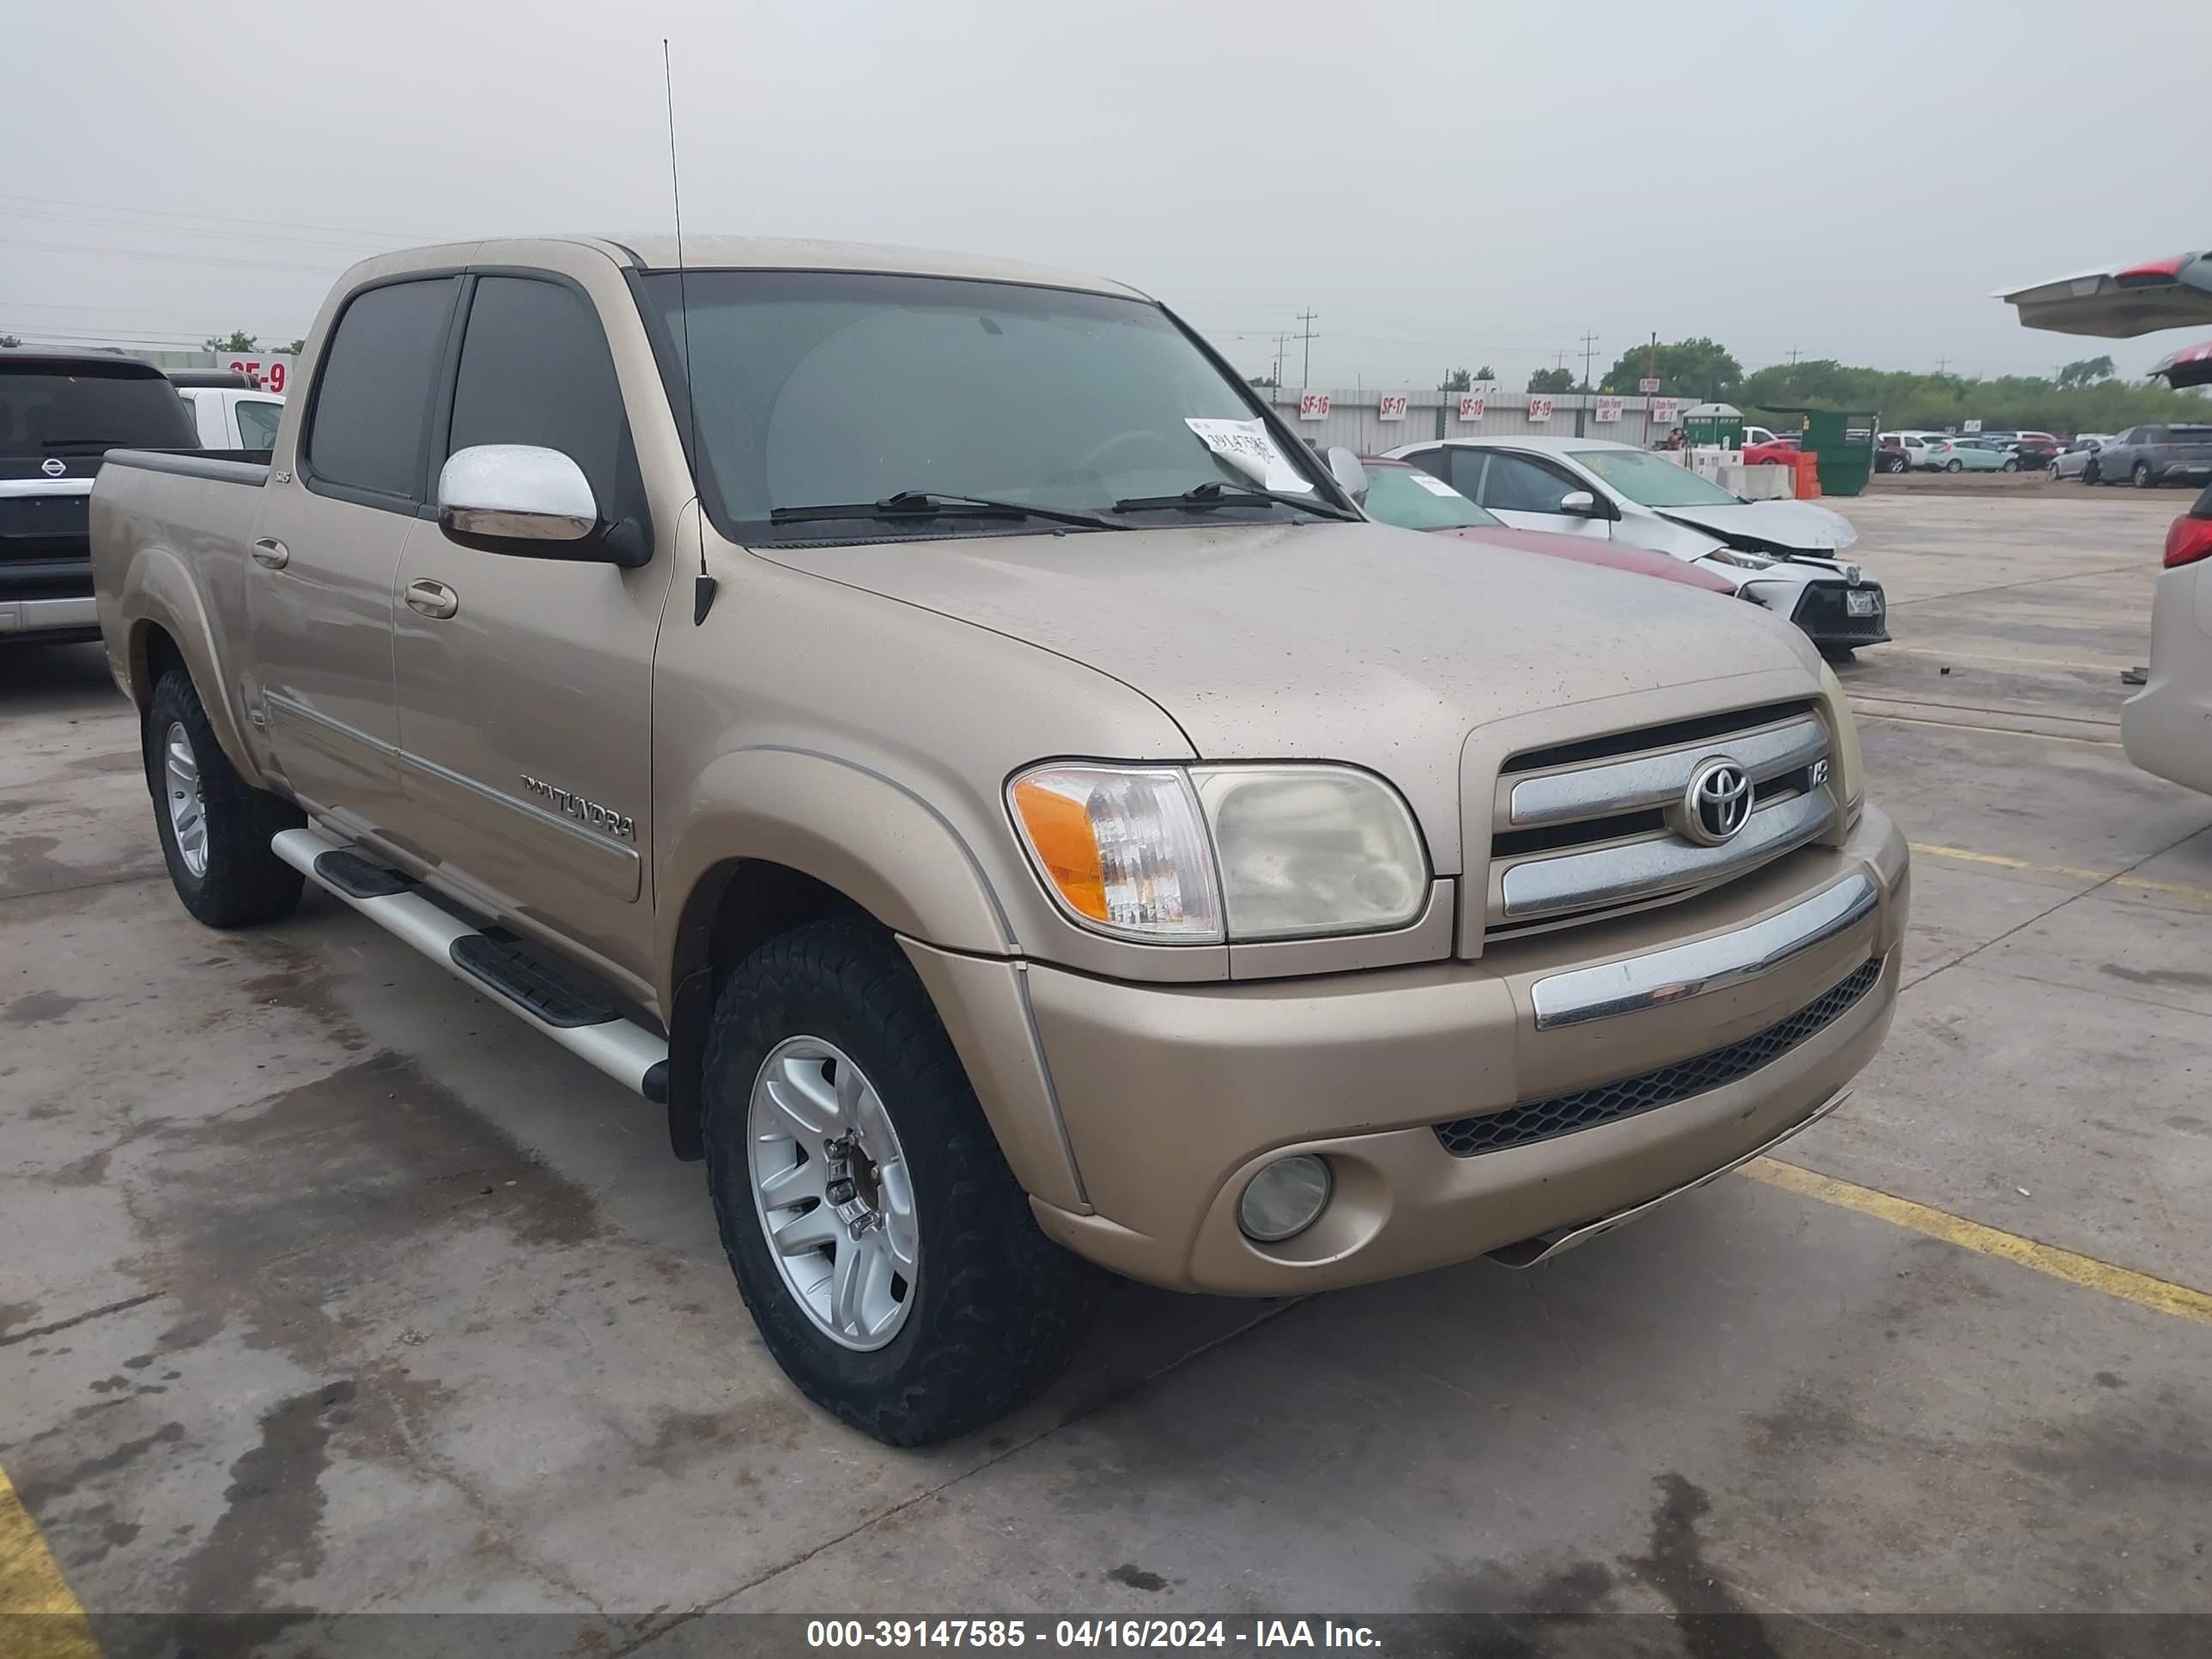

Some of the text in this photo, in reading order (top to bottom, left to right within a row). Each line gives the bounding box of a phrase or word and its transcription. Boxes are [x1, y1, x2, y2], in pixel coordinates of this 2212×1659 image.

[1302, 396, 1330, 414] SF-16
[1382, 398, 1407, 415] SF-17
[1462, 398, 1484, 416] SF-18
[1530, 400, 1552, 416] SF-19
[553, 787, 637, 842] TUNDRA
